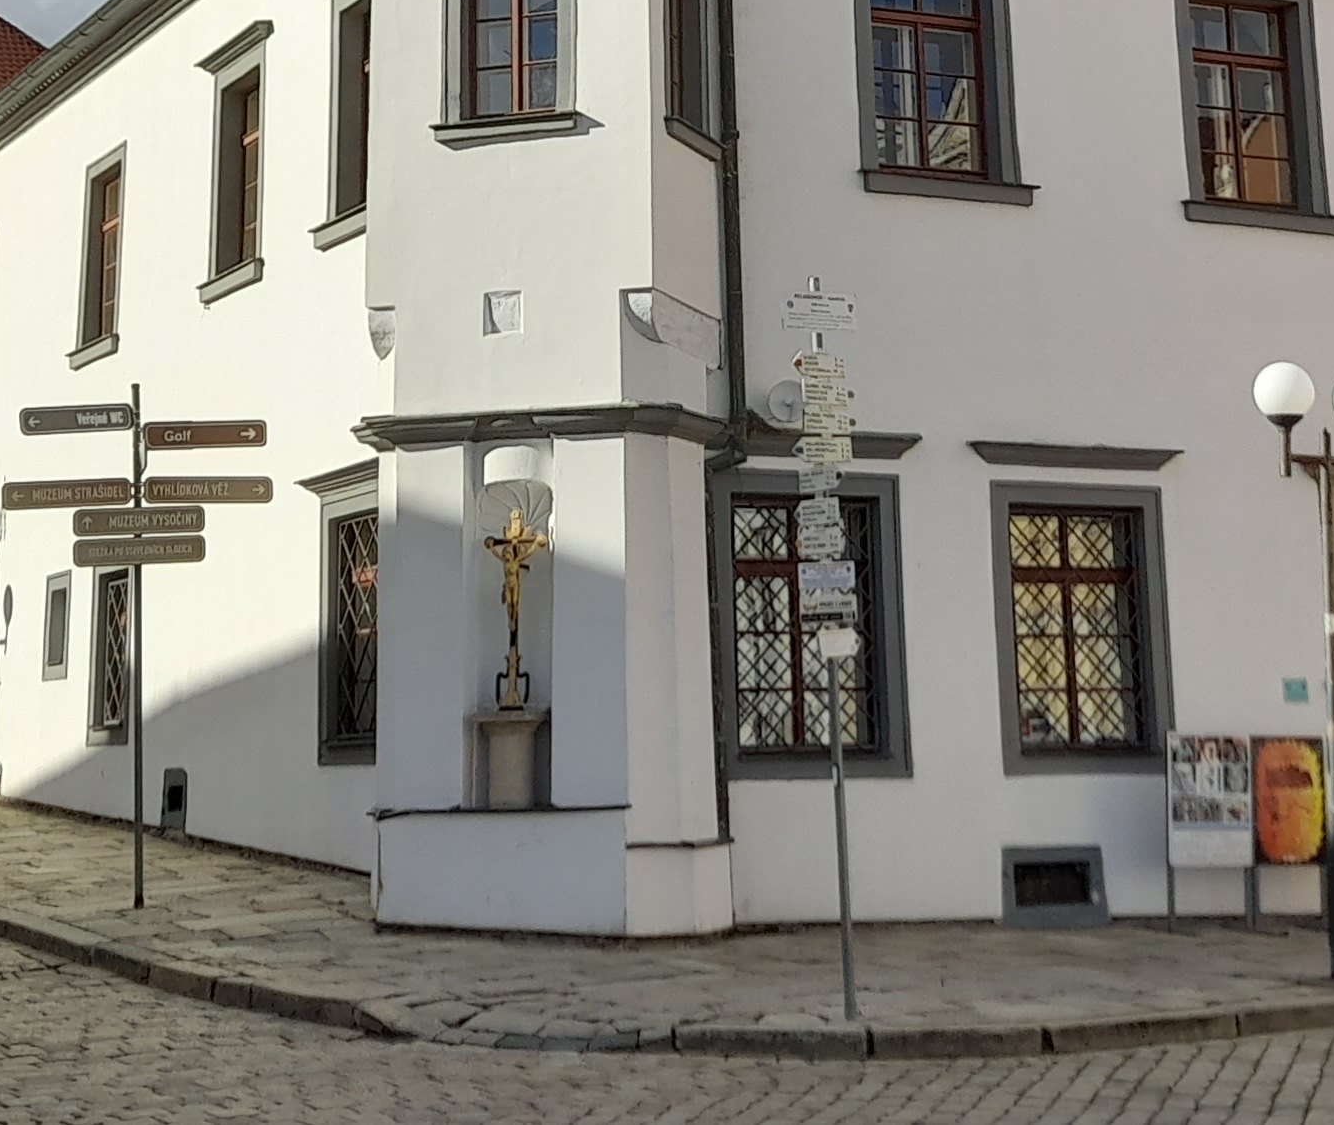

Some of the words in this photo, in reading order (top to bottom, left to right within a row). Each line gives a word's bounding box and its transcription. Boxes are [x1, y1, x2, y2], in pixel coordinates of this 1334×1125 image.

[109, 411, 124, 424] WC
[164, 429, 192, 442] Golf
[32, 487, 72, 502] MUZEUM
[74, 484, 125, 500] STRAŠIDEL
[152, 481, 209, 496] VYHLÍDKOVÁ
[109, 515, 149, 529] MUZEUM
[151, 511, 198, 526] VYSOČINY
